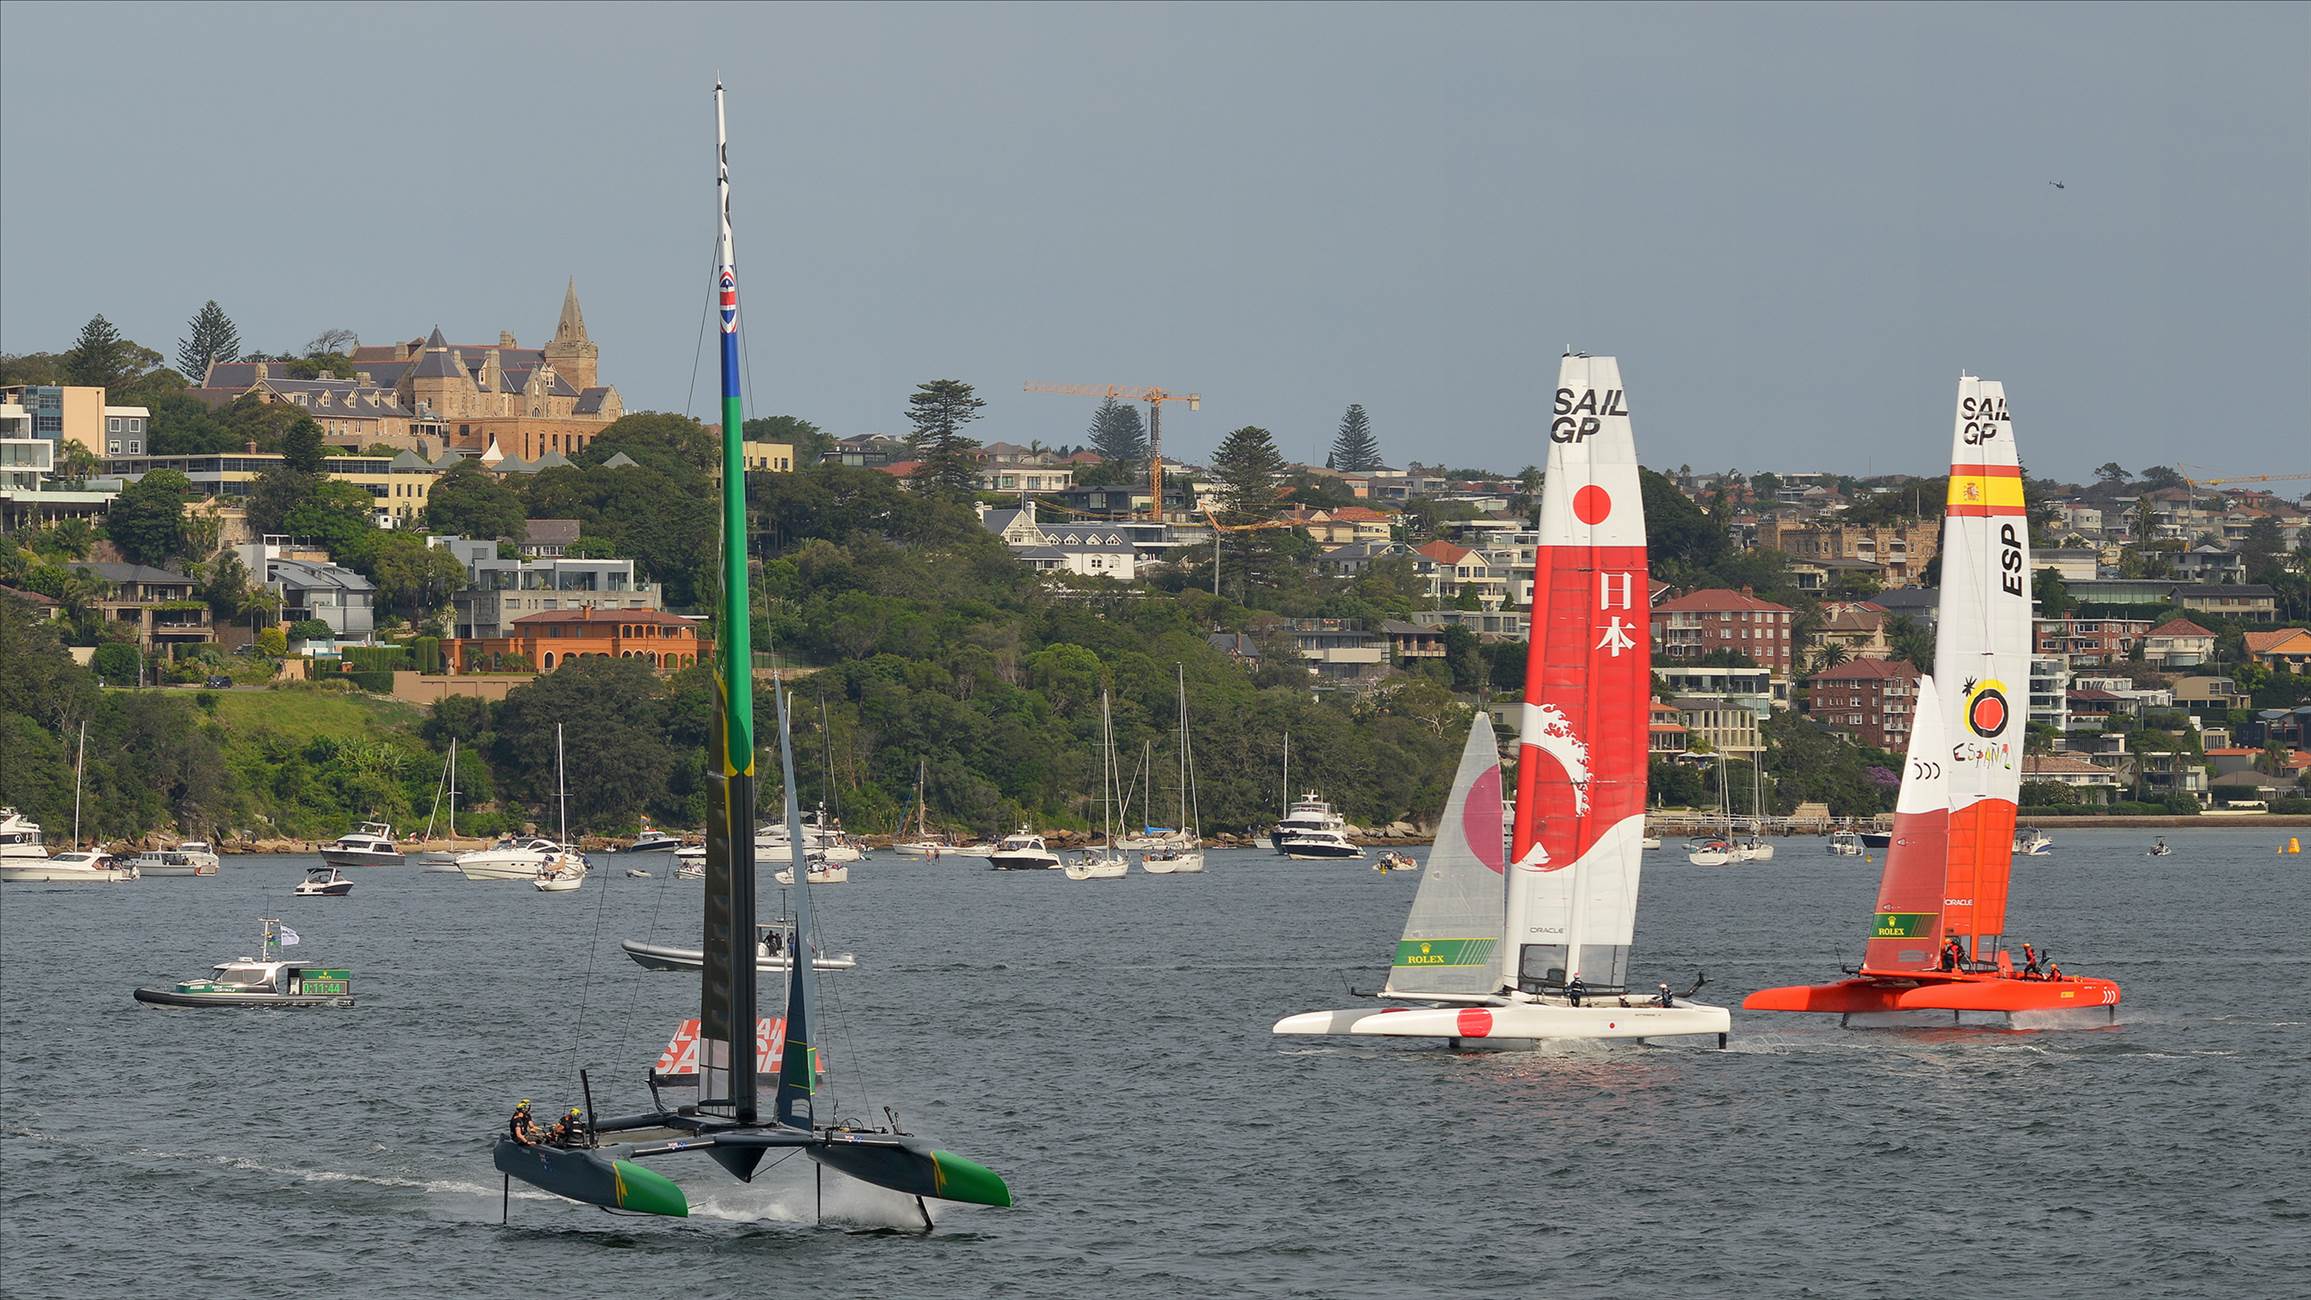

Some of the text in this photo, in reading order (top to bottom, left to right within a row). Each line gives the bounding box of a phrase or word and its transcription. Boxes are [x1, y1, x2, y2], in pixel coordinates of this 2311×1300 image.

[1553, 387, 1629, 416] SAIL
[1960, 397, 2010, 421] SAIL
[1550, 416, 1601, 444] GP
[1963, 421, 1997, 446] GP
[2000, 523, 2023, 598] ESP
[1595, 571, 1637, 657] 日本
[1944, 898, 1974, 906] ORACLE
[1878, 927, 1905, 936] ROLEX
[1407, 955, 1445, 964] ROLEX
